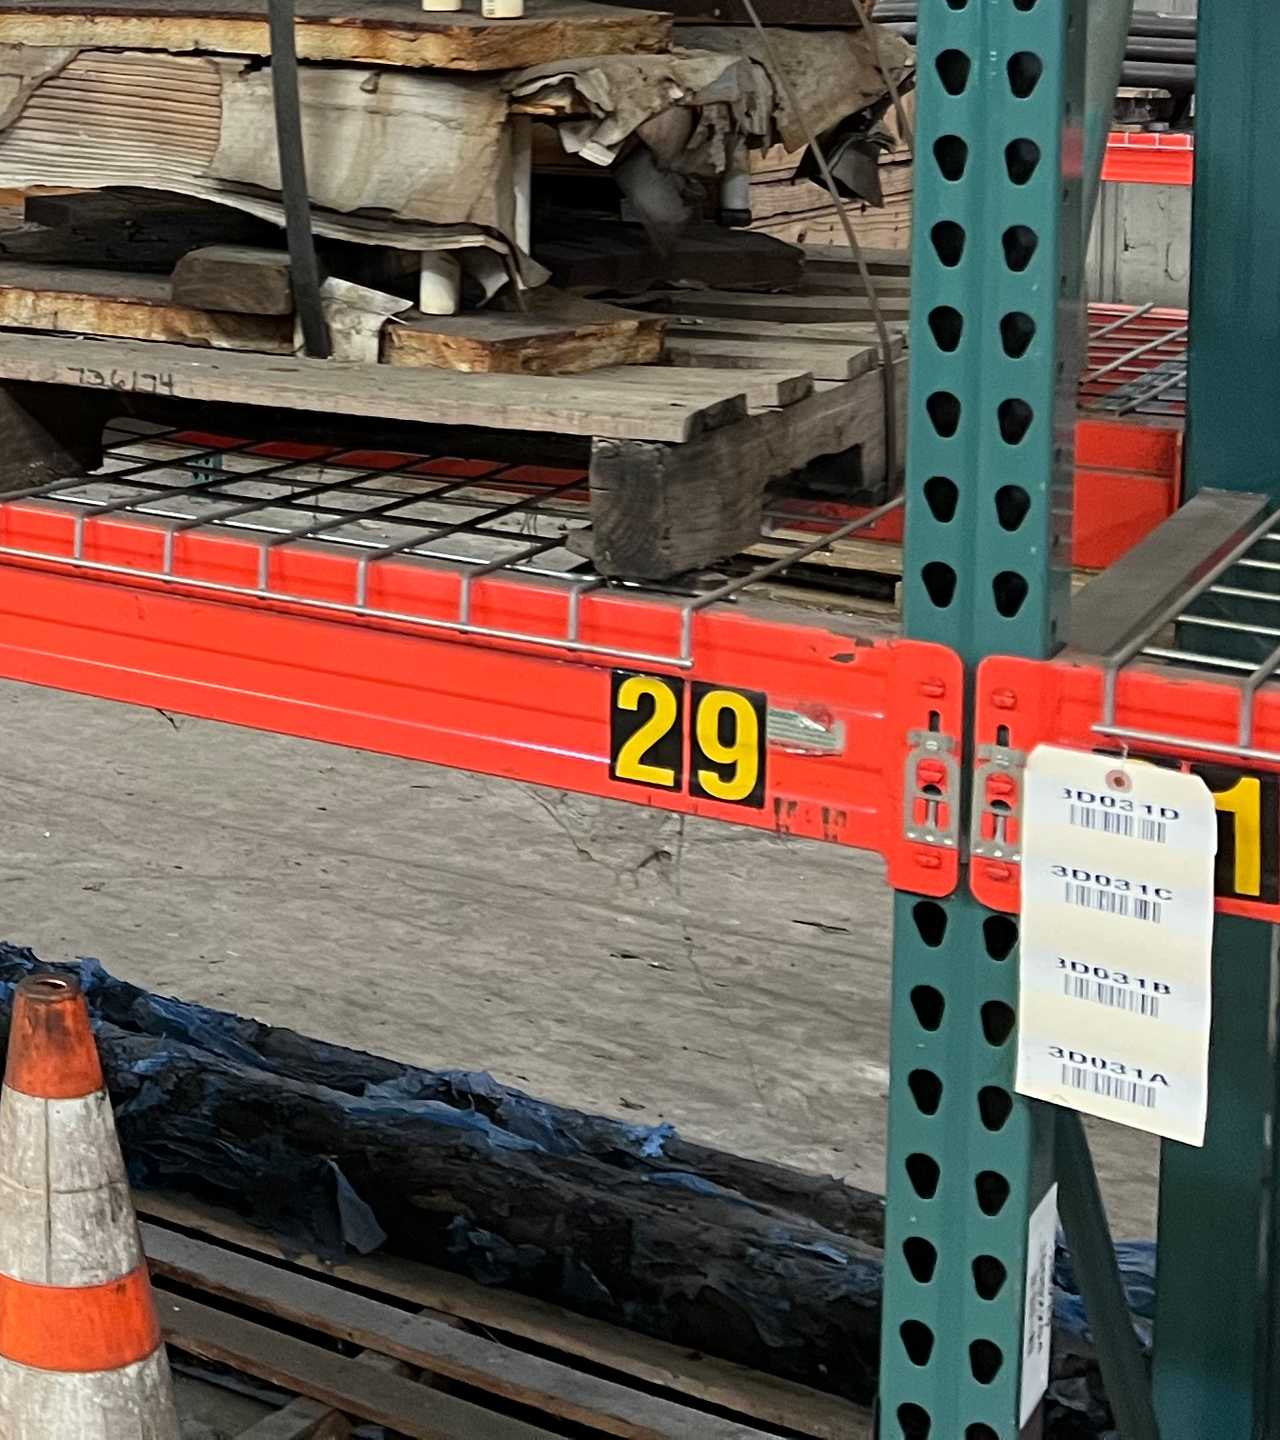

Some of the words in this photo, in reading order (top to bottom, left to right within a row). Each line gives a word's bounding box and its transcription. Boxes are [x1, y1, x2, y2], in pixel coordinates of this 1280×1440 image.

[615, 675, 759, 801] 29
[1061, 787, 1180, 822] 3D031D
[1050, 864, 1173, 902] 3D031C
[1057, 956, 1171, 996] 3D031B
[1048, 1046, 1170, 1088] 3D031A
